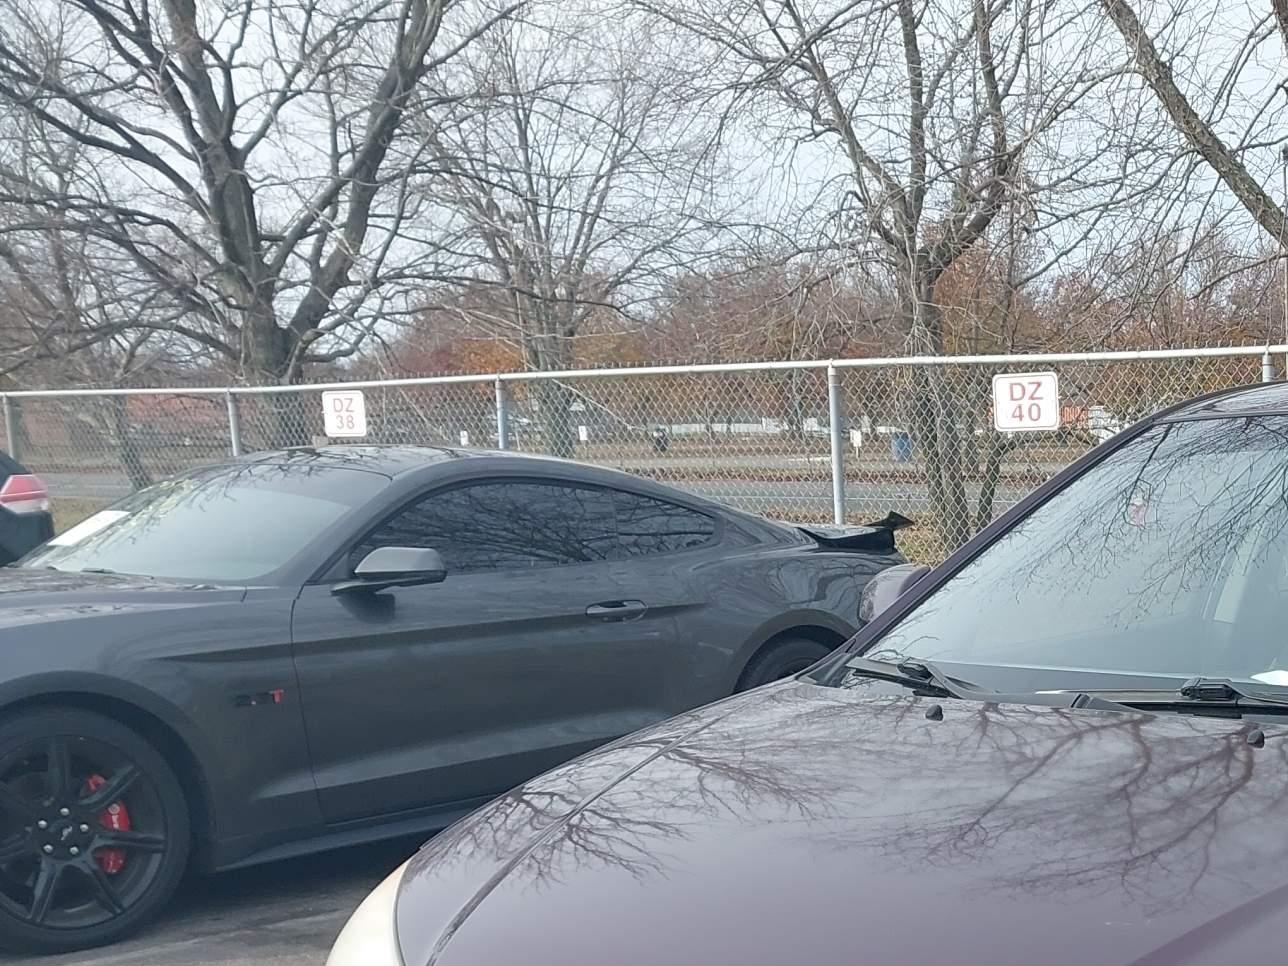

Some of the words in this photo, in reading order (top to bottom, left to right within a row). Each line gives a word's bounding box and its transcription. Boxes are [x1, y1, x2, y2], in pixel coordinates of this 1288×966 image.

[1009, 381, 1044, 401] DZ
[333, 397, 355, 412] DZ
[1011, 402, 1041, 422] 40
[336, 414, 355, 429] 38
